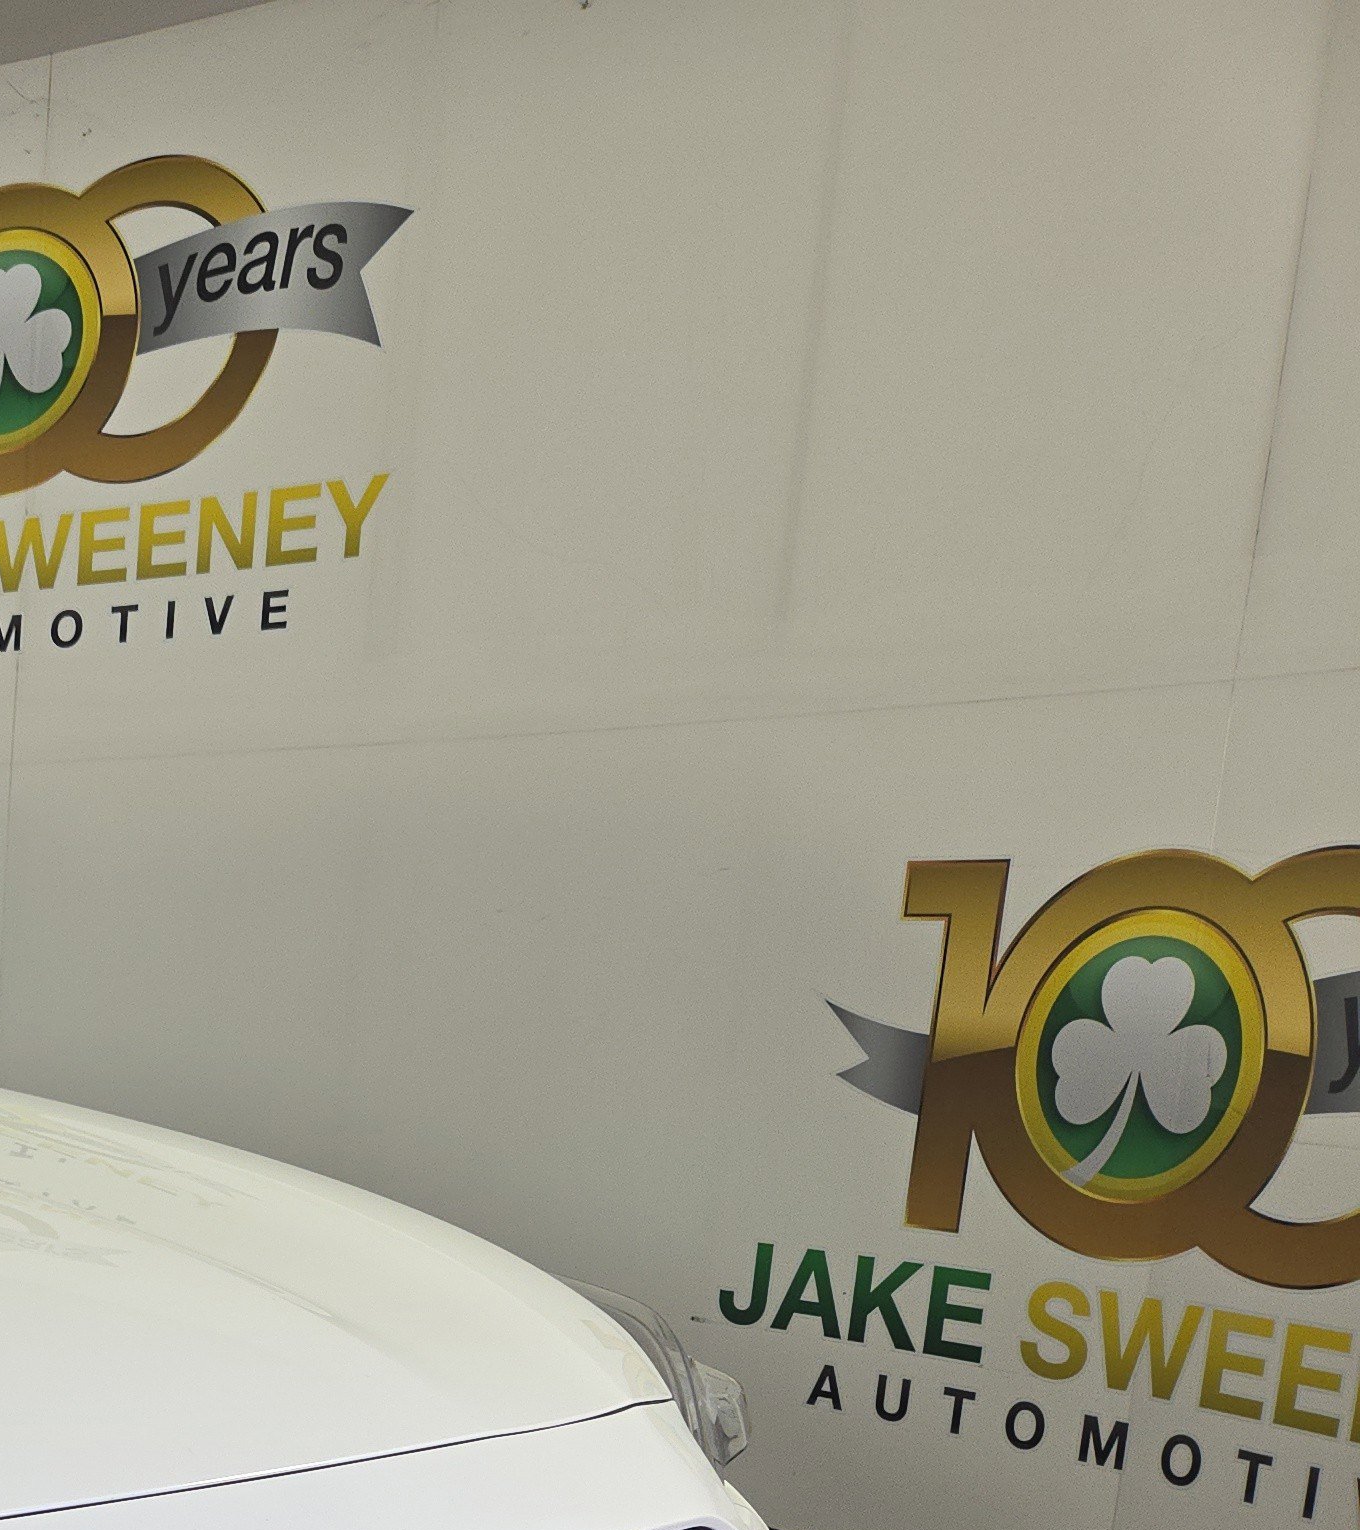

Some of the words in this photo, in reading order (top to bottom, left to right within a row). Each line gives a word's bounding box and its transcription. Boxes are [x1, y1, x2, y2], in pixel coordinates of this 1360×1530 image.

[151, 222, 349, 337] years
[718, 1241, 992, 1364] JAKE
[1019, 1280, 1360, 1444] SWEE
[806, 1363, 1360, 1520] AUTOMOTI
